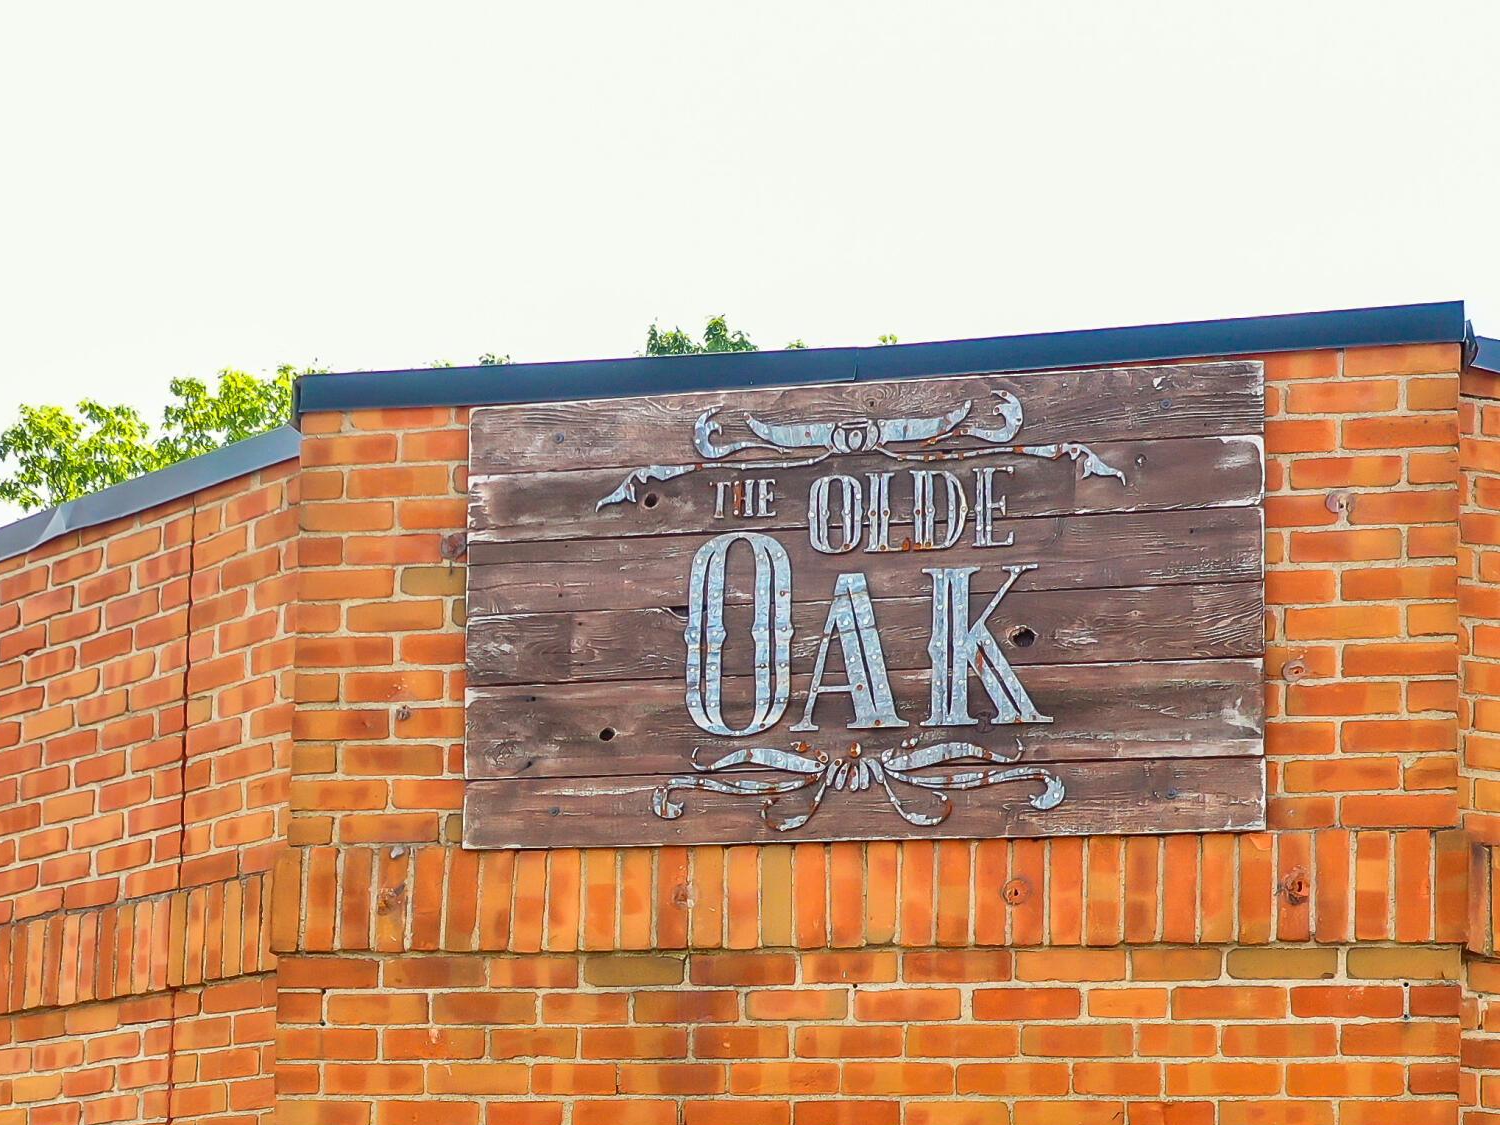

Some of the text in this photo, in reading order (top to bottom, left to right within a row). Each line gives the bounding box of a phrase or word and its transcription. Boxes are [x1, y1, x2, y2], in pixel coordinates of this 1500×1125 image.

[709, 465, 1017, 554] THE OLDE
[683, 532, 1055, 737] OAK
